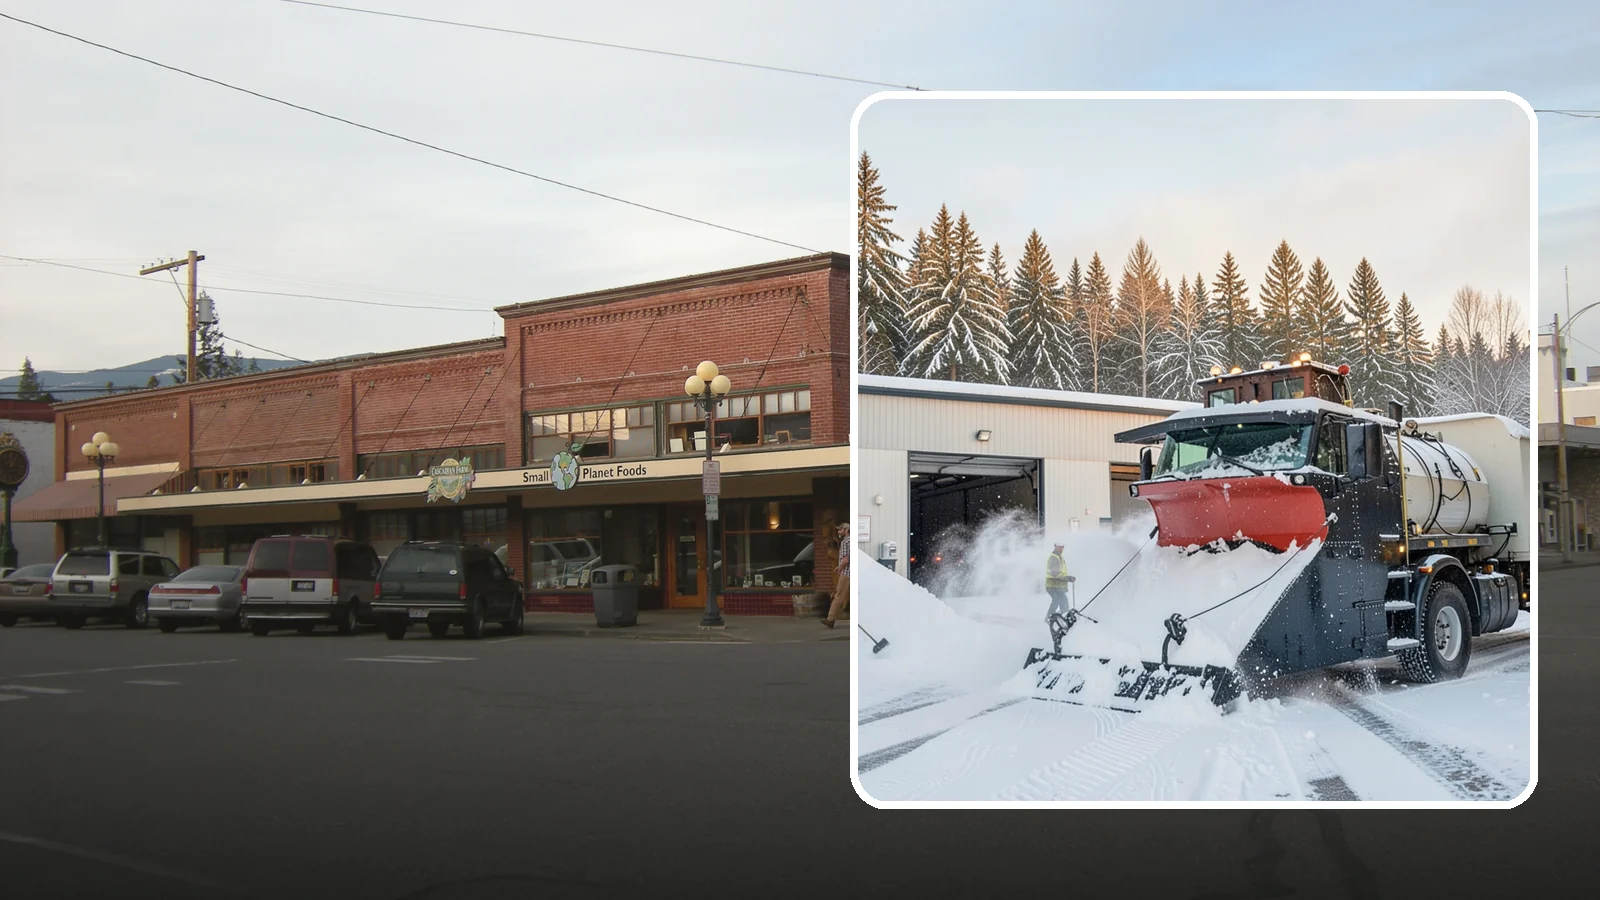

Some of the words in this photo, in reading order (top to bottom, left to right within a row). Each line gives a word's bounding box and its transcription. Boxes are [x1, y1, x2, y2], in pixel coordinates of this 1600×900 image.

[523, 471, 549, 483] Small
[583, 468, 614, 480] Planet
[617, 464, 647, 477] Foods
